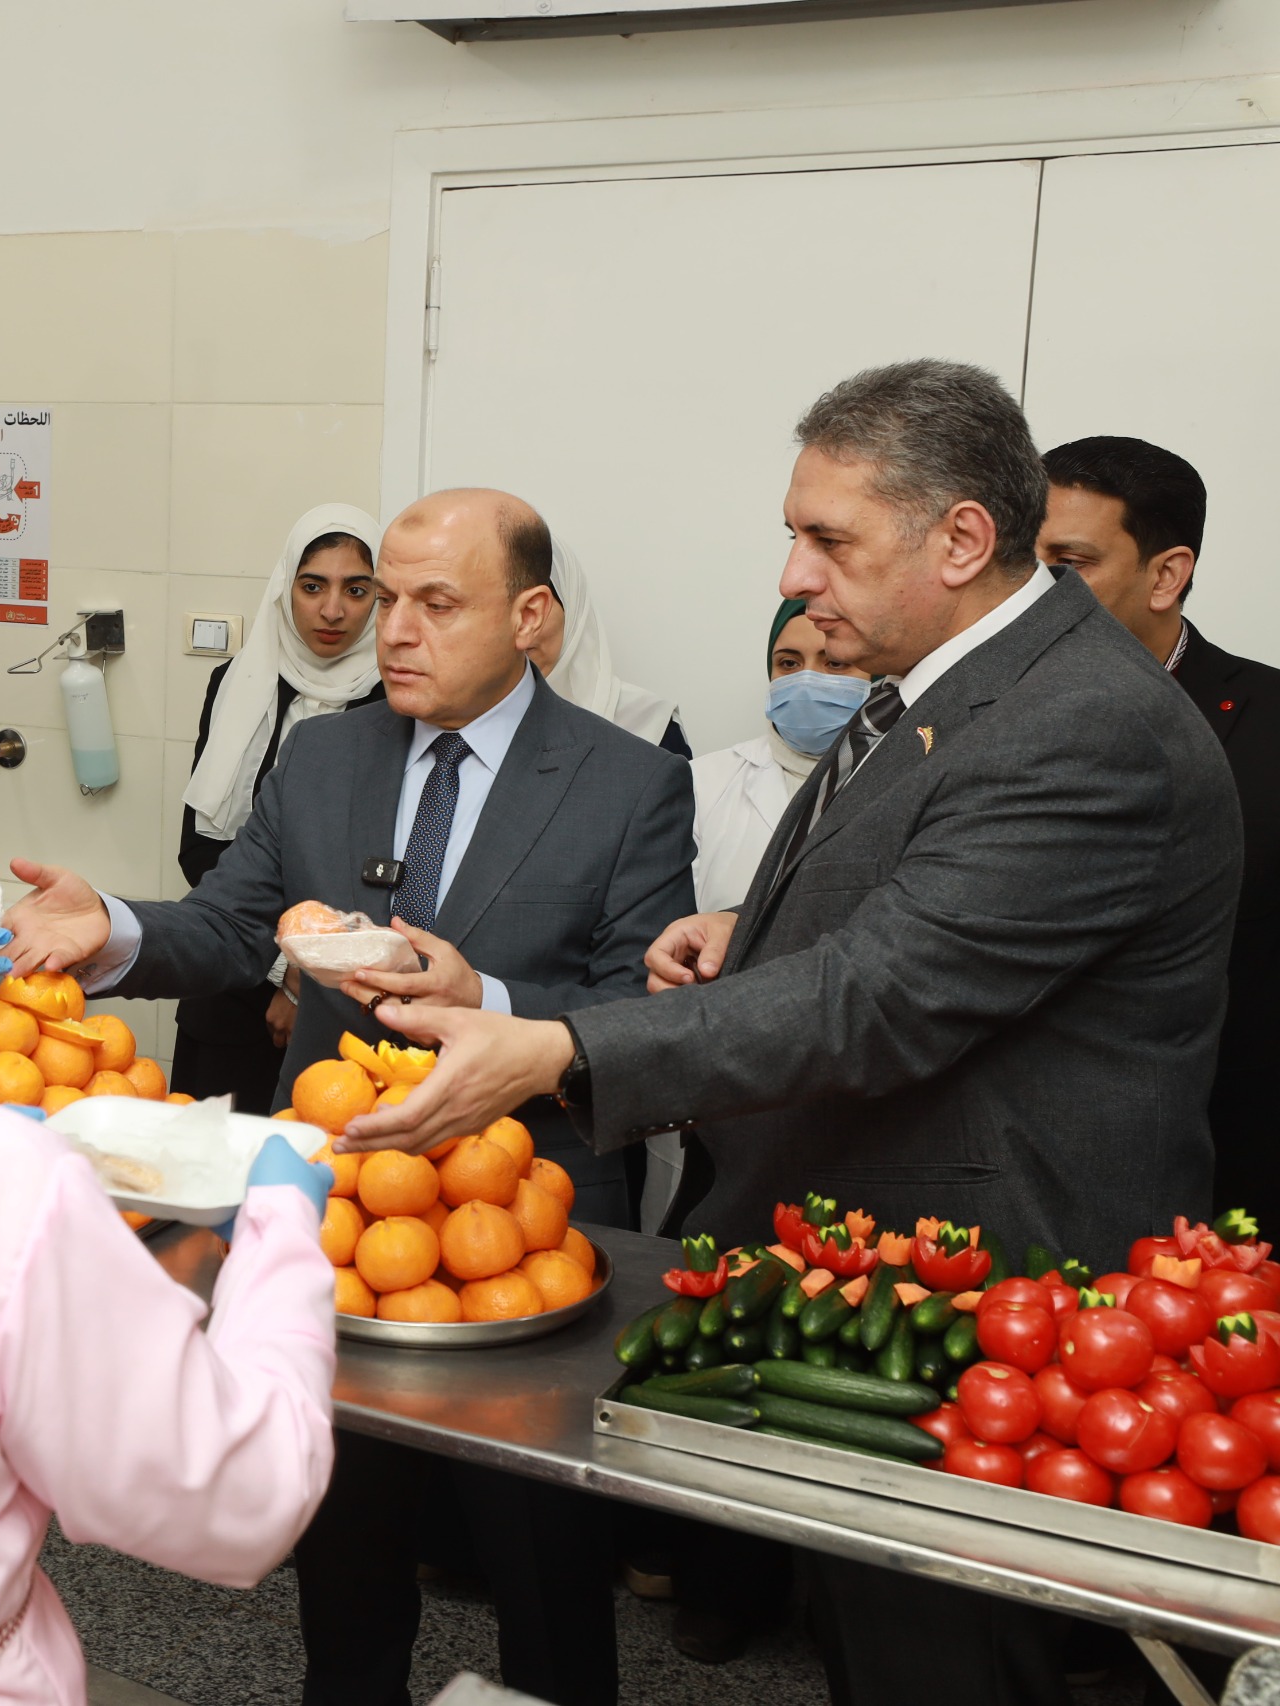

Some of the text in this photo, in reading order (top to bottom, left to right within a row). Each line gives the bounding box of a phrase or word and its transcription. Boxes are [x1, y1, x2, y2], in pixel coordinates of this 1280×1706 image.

[4, 410, 51, 426] اللحظات
[33, 485, 38, 496] 1
[11, 515, 19, 526] 3
